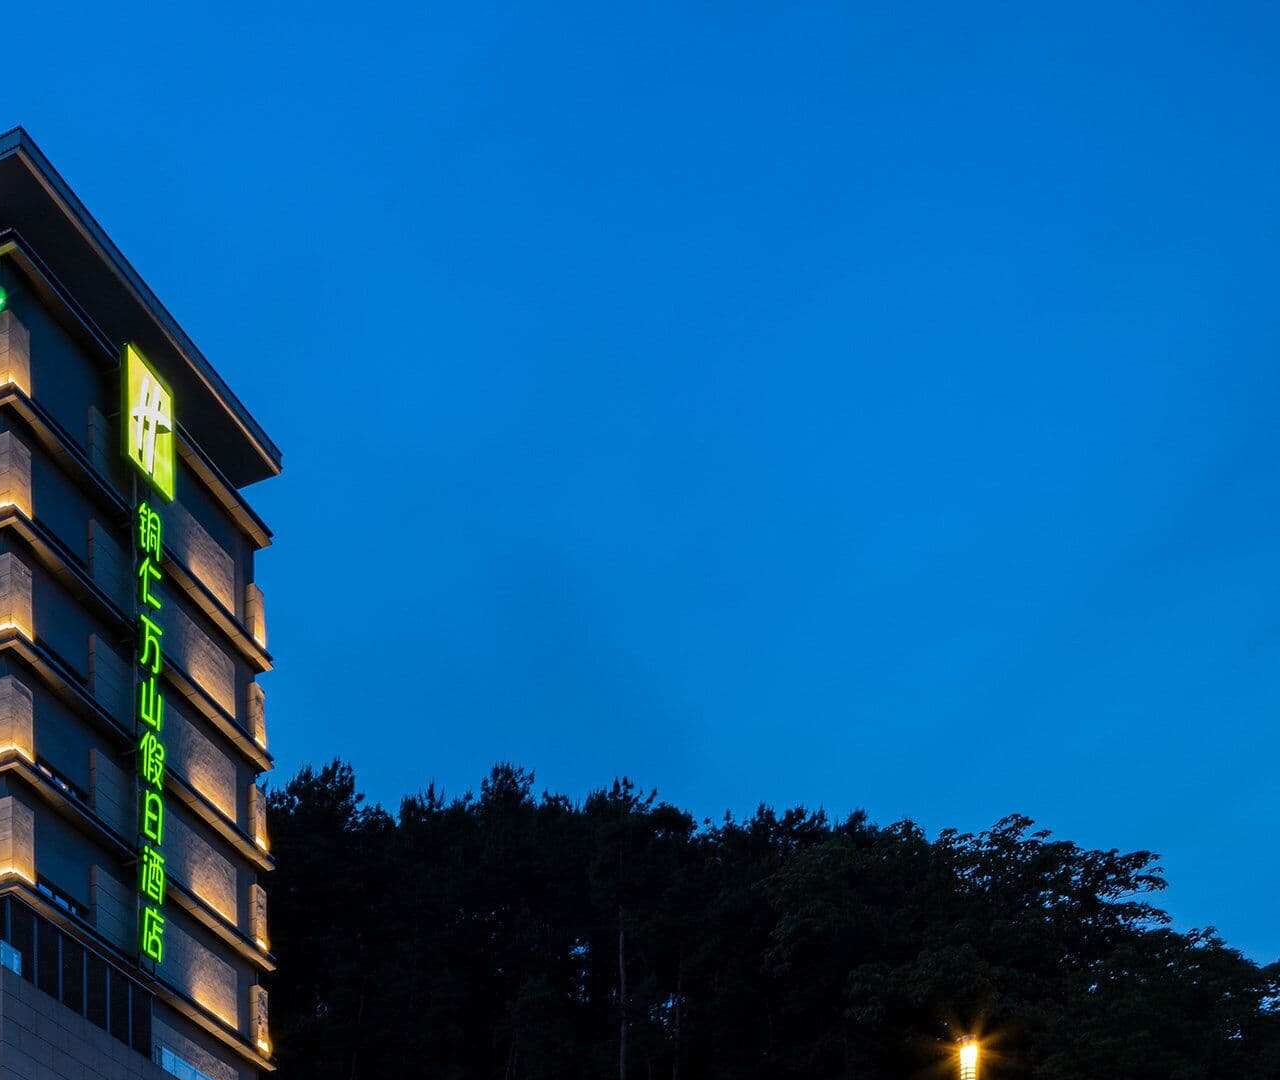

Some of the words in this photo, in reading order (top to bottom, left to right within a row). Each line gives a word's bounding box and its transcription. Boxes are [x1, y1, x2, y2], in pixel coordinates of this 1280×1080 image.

[139, 503, 164, 963] 铜仁万山假日酒店
